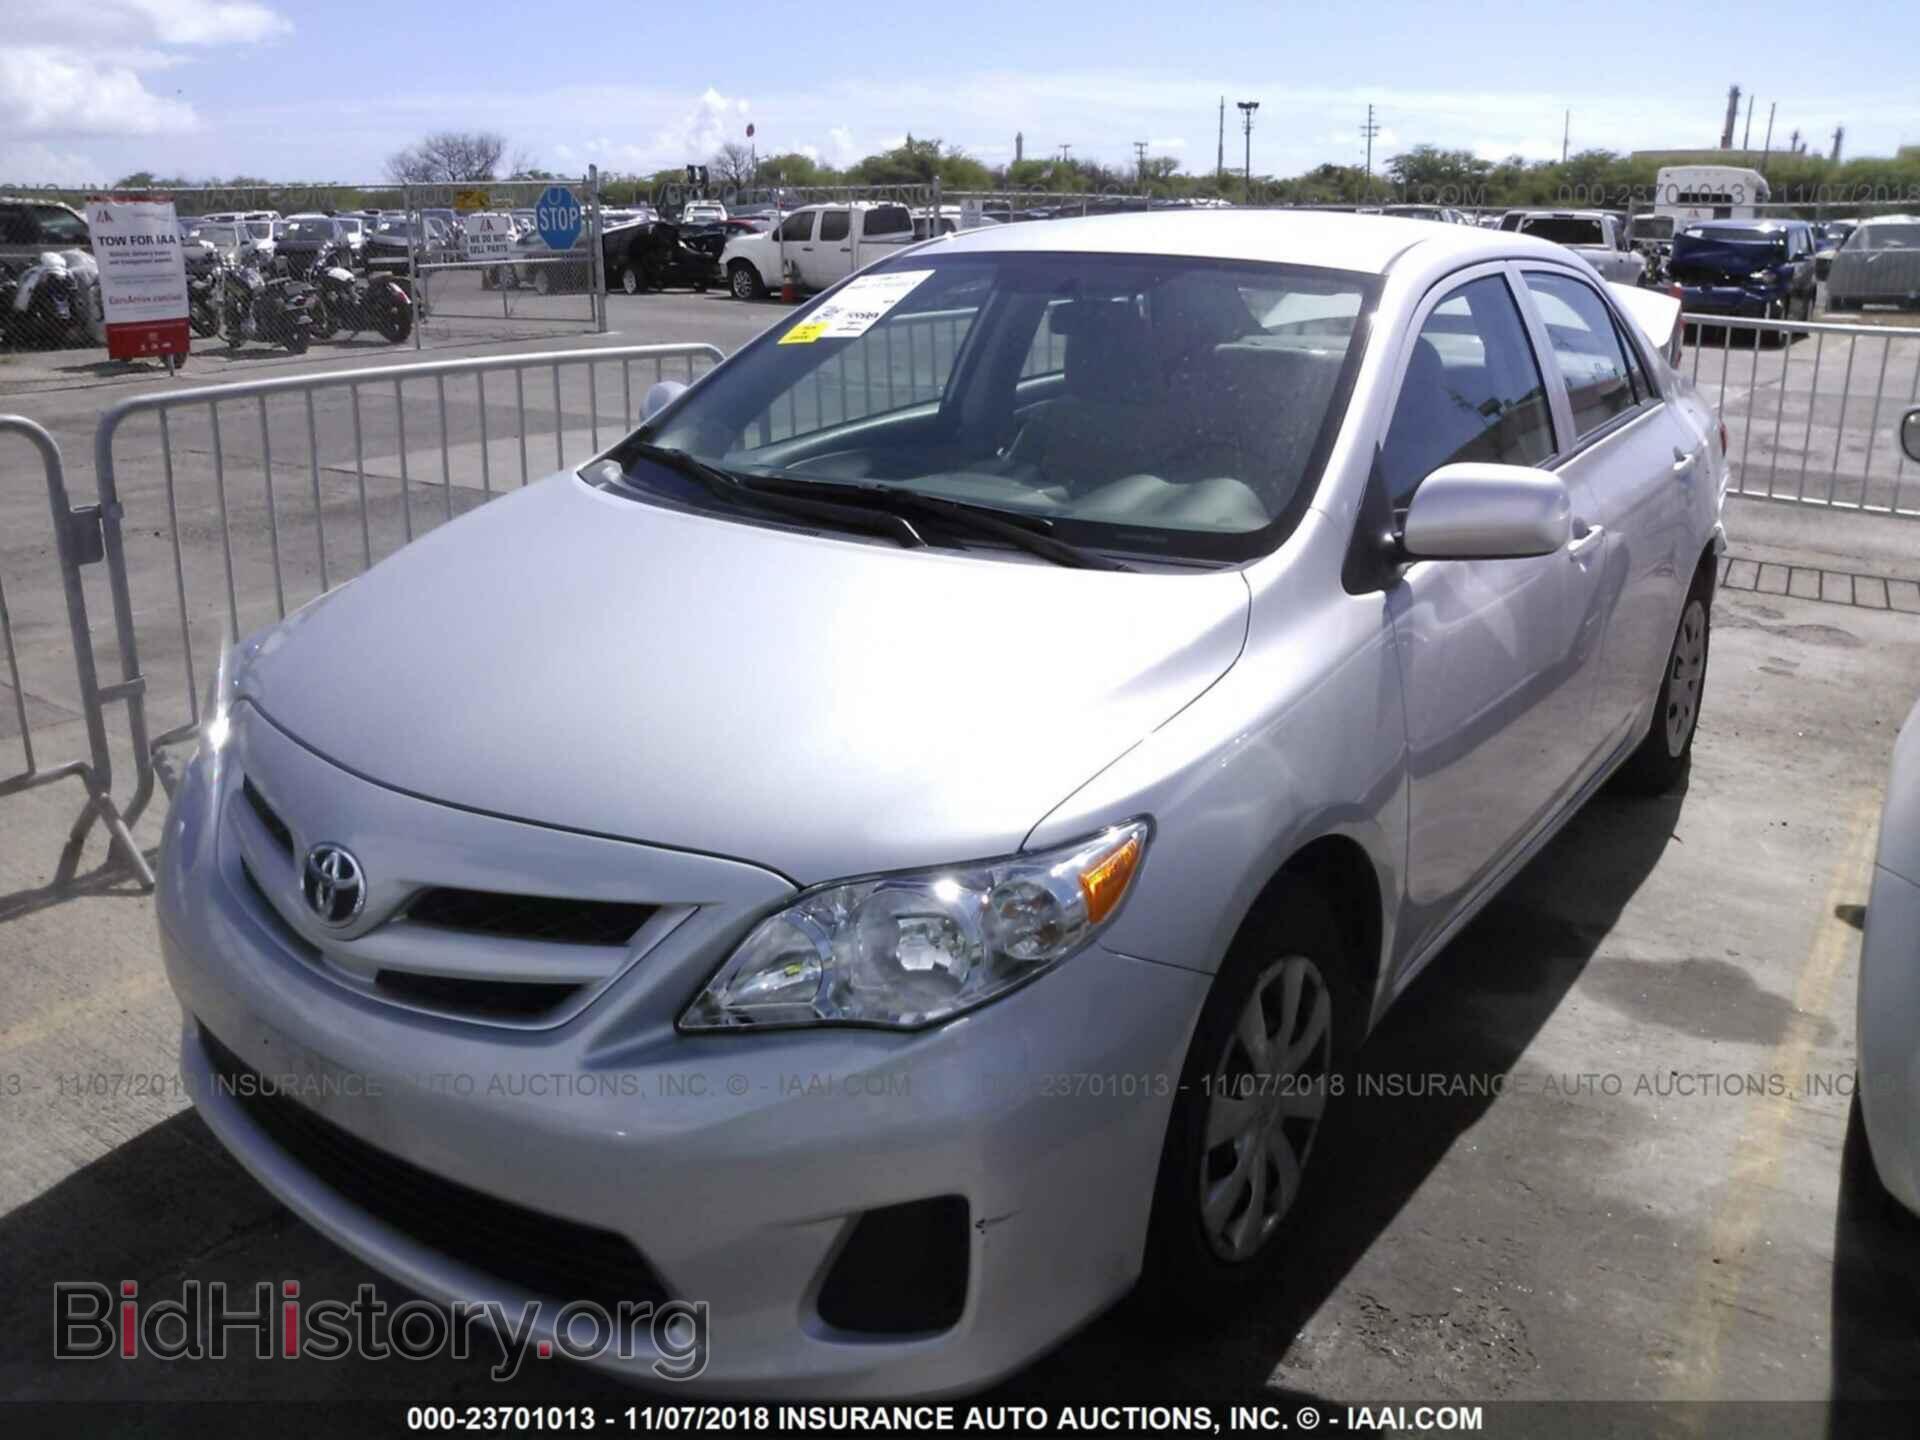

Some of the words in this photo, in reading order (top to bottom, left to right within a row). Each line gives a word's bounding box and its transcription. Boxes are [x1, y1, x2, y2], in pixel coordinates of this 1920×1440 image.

[539, 206, 579, 231] STOP
[97, 235, 127, 247] TOW
[130, 234, 154, 246] FOR
[156, 233, 177, 245] IAA
